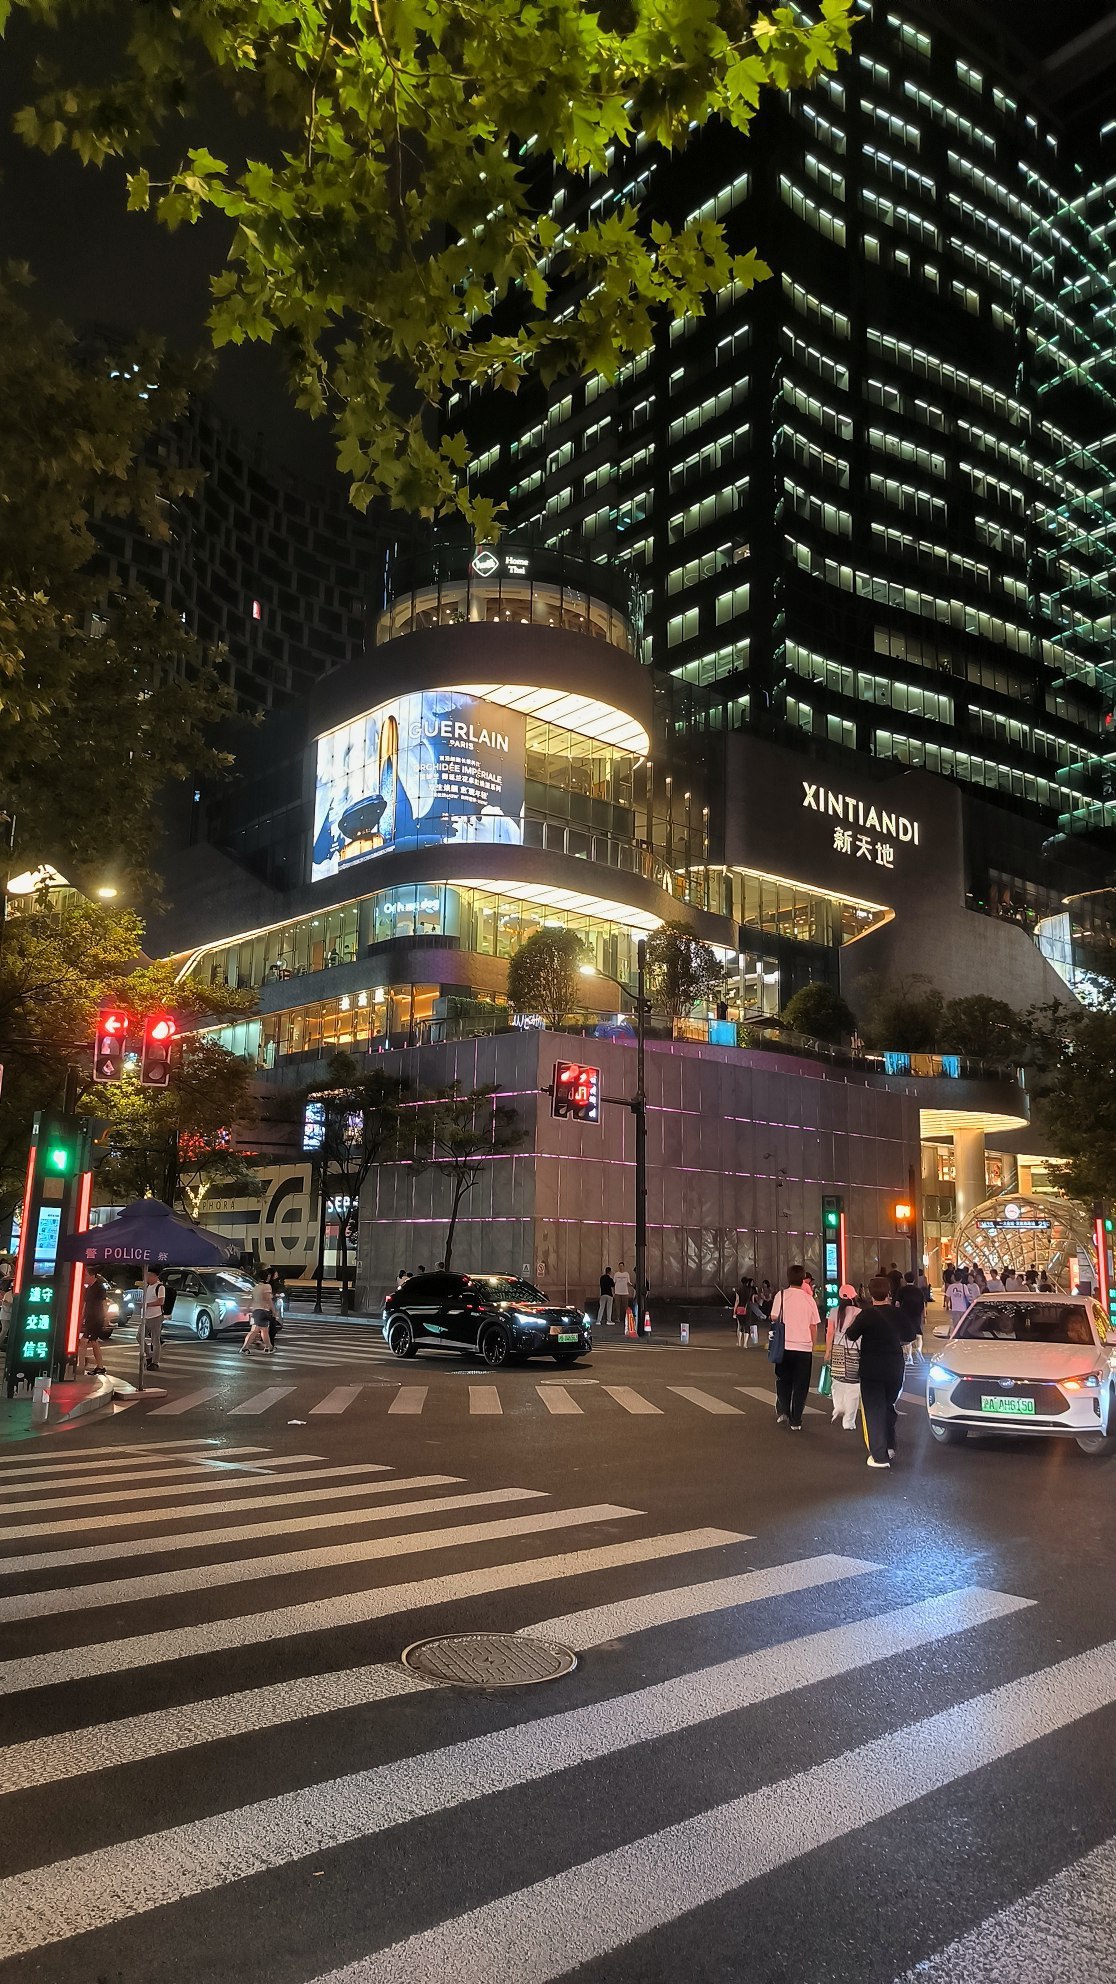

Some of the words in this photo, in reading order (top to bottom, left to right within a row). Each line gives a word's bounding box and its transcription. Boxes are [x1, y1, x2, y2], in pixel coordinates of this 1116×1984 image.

[505, 556, 529, 566] Home
[408, 719, 510, 753] GUERLAIN
[449, 739, 475, 751] PARIS
[802, 781, 919, 846] XINTIANDI
[832, 826, 895, 869] 新天地
[104, 1247, 152, 1261] POLICE
[158, 1251, 169, 1261] 察
[24, 1314, 50, 1330] 交通
[22, 1340, 49, 1358] 信号
